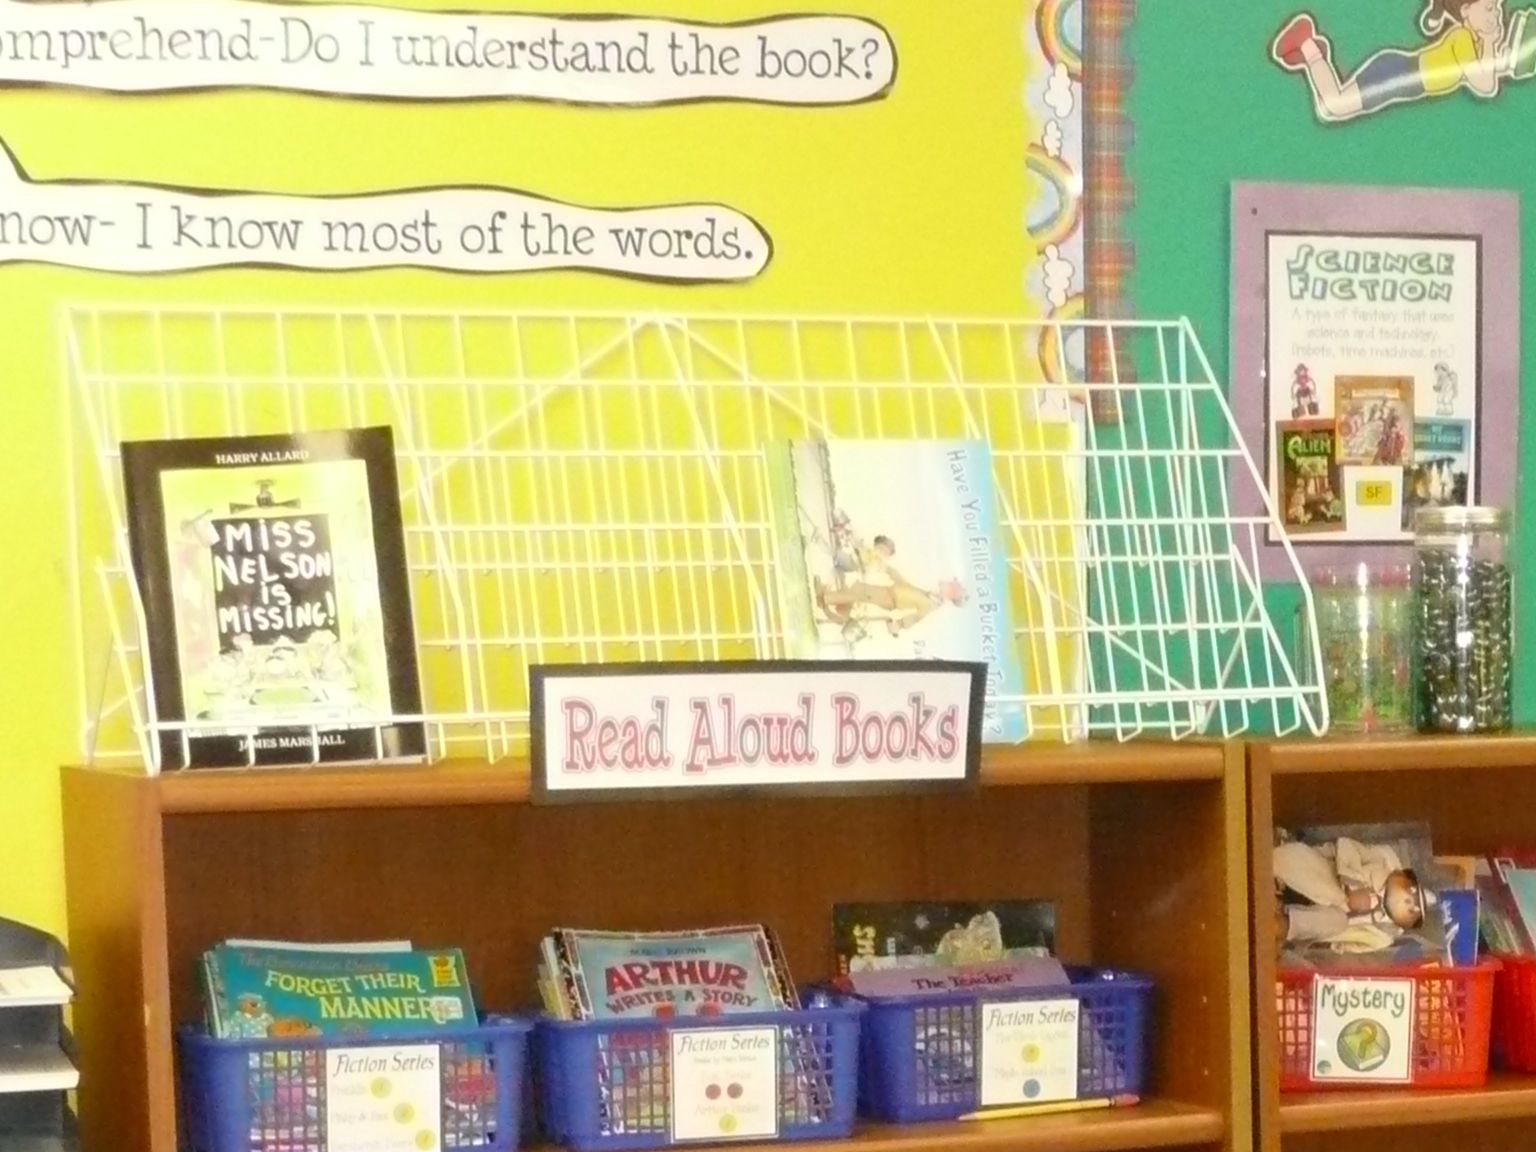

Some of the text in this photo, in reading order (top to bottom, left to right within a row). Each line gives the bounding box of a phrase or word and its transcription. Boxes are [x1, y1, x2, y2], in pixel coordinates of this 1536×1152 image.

[358, 20, 376, 68] I
[393, 25, 654, 76] understand
[666, 31, 741, 78] the
[755, 36, 882, 81] book?
[136, 202, 152, 250] I
[171, 204, 303, 253] know
[321, 213, 443, 256] most
[459, 211, 509, 256] of
[519, 211, 596, 257] the
[608, 217, 755, 263] words.
[1286, 243, 1456, 276] SCIENCE
[1288, 271, 1453, 303] FICTION
[215, 451, 259, 465] HARRY
[1365, 485, 1384, 499] SF
[945, 448, 970, 494] Have
[960, 499, 981, 528] You
[972, 536, 989, 586] Filled
[213, 551, 333, 591] NELSON
[560, 689, 960, 776] Read Aloud Books
[264, 969, 427, 998] FORGET THEIR
[604, 959, 750, 996] ARTHUR
[911, 977, 944, 991] The
[319, 995, 447, 1024] MANNER
[605, 989, 677, 1015] WRITES
[702, 987, 758, 1009] STORY
[1320, 982, 1406, 1019] Mystery
[986, 1006, 1077, 1030] Fiction Series
[677, 1030, 771, 1056] Fiction Series
[332, 1050, 436, 1078] Fiction Series
